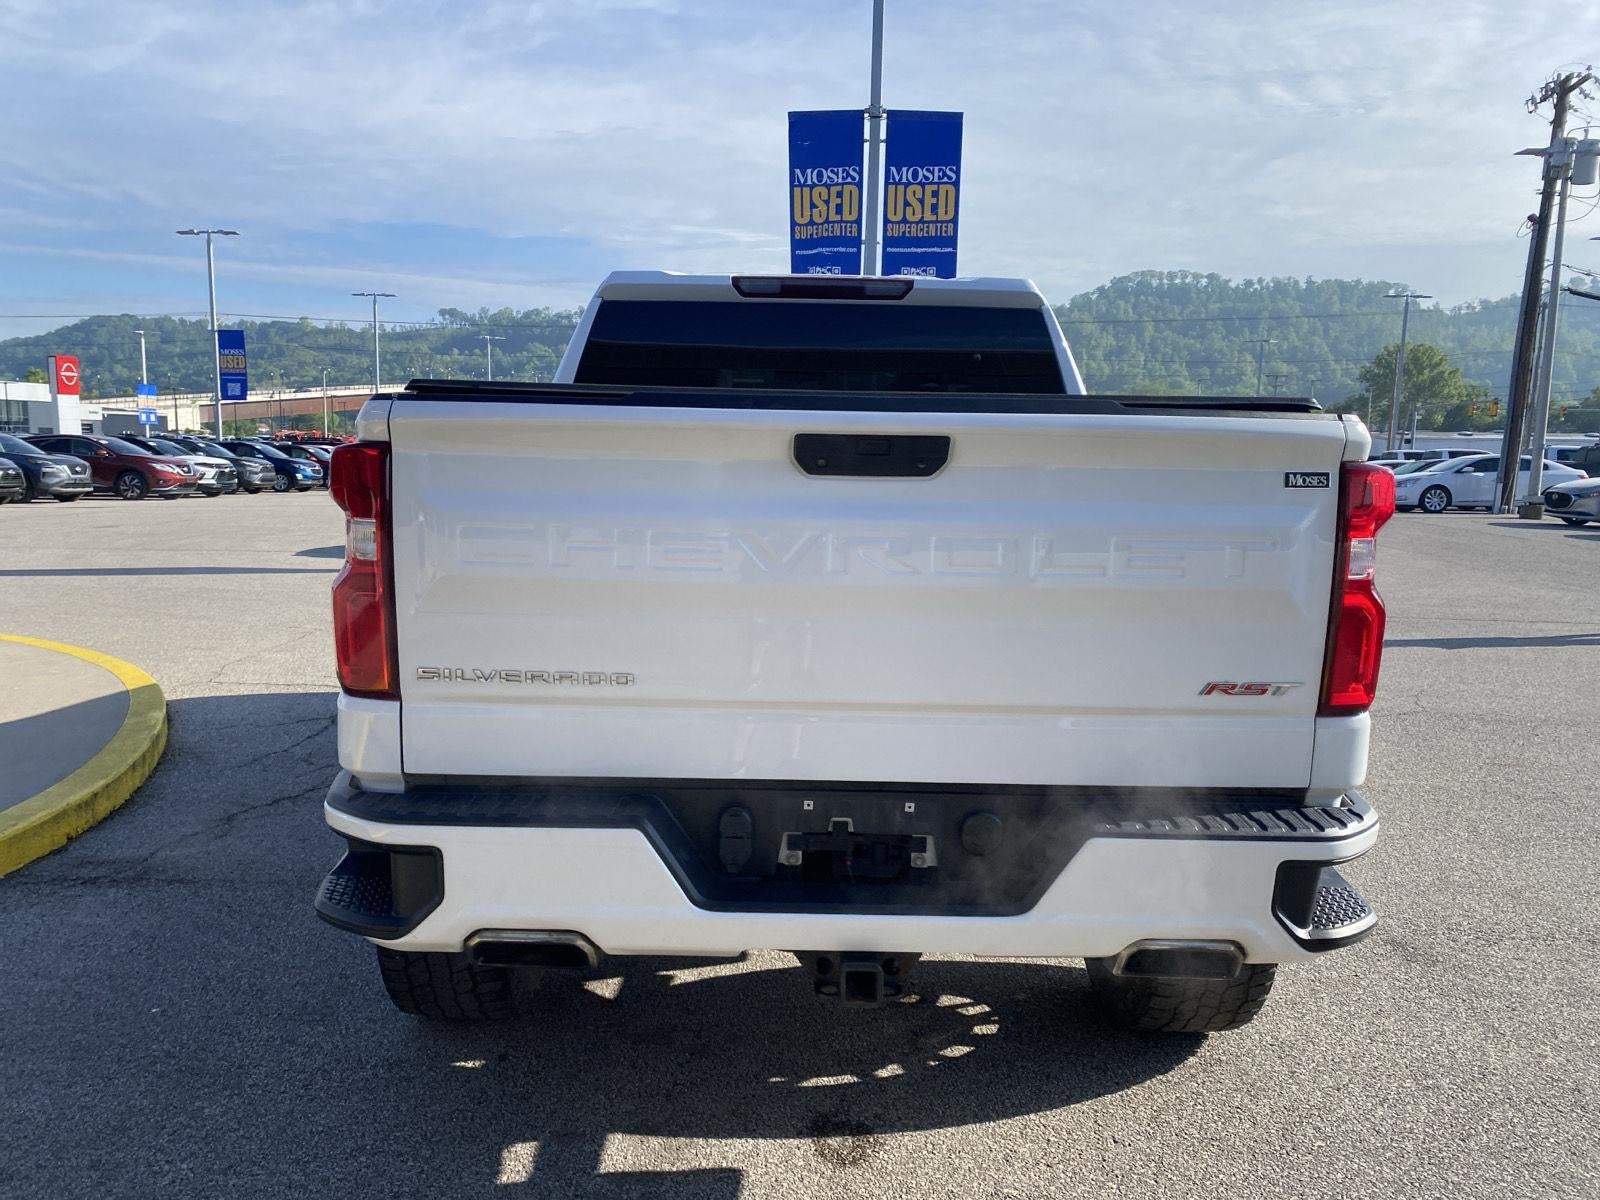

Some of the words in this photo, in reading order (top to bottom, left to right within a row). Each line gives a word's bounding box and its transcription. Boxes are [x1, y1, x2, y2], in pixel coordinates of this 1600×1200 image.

[793, 166, 860, 185] MOSES
[888, 166, 957, 184] MOSES
[793, 185, 859, 224] USED
[887, 184, 956, 222] USED
[794, 223, 858, 240] SUPERCENTER
[886, 223, 954, 237] SUPERCENTER
[220, 355, 246, 369] USED
[456, 521, 1280, 580] CHEVROLET
[416, 666, 636, 686] SILVERADO
[1198, 681, 1304, 696] RST
